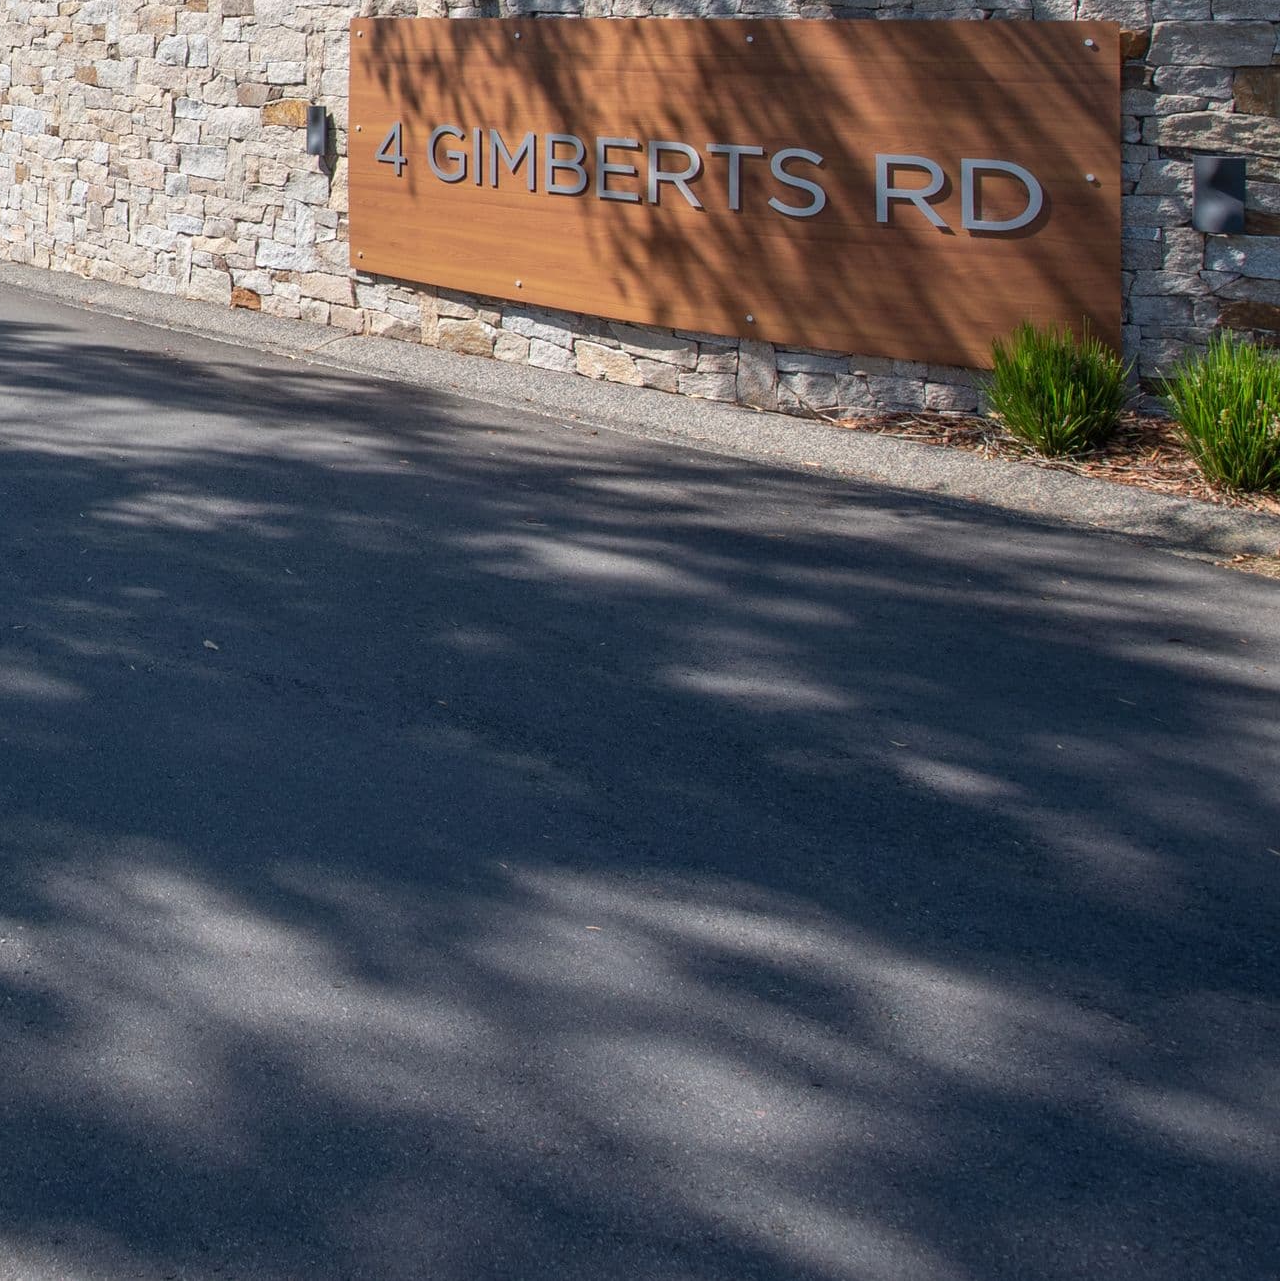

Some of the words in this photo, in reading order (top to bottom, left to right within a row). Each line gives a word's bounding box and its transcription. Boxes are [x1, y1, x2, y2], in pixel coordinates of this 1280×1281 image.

[374, 121, 407, 176] 4
[427, 124, 827, 218] GIMBERTS
[875, 153, 1044, 231] RD
